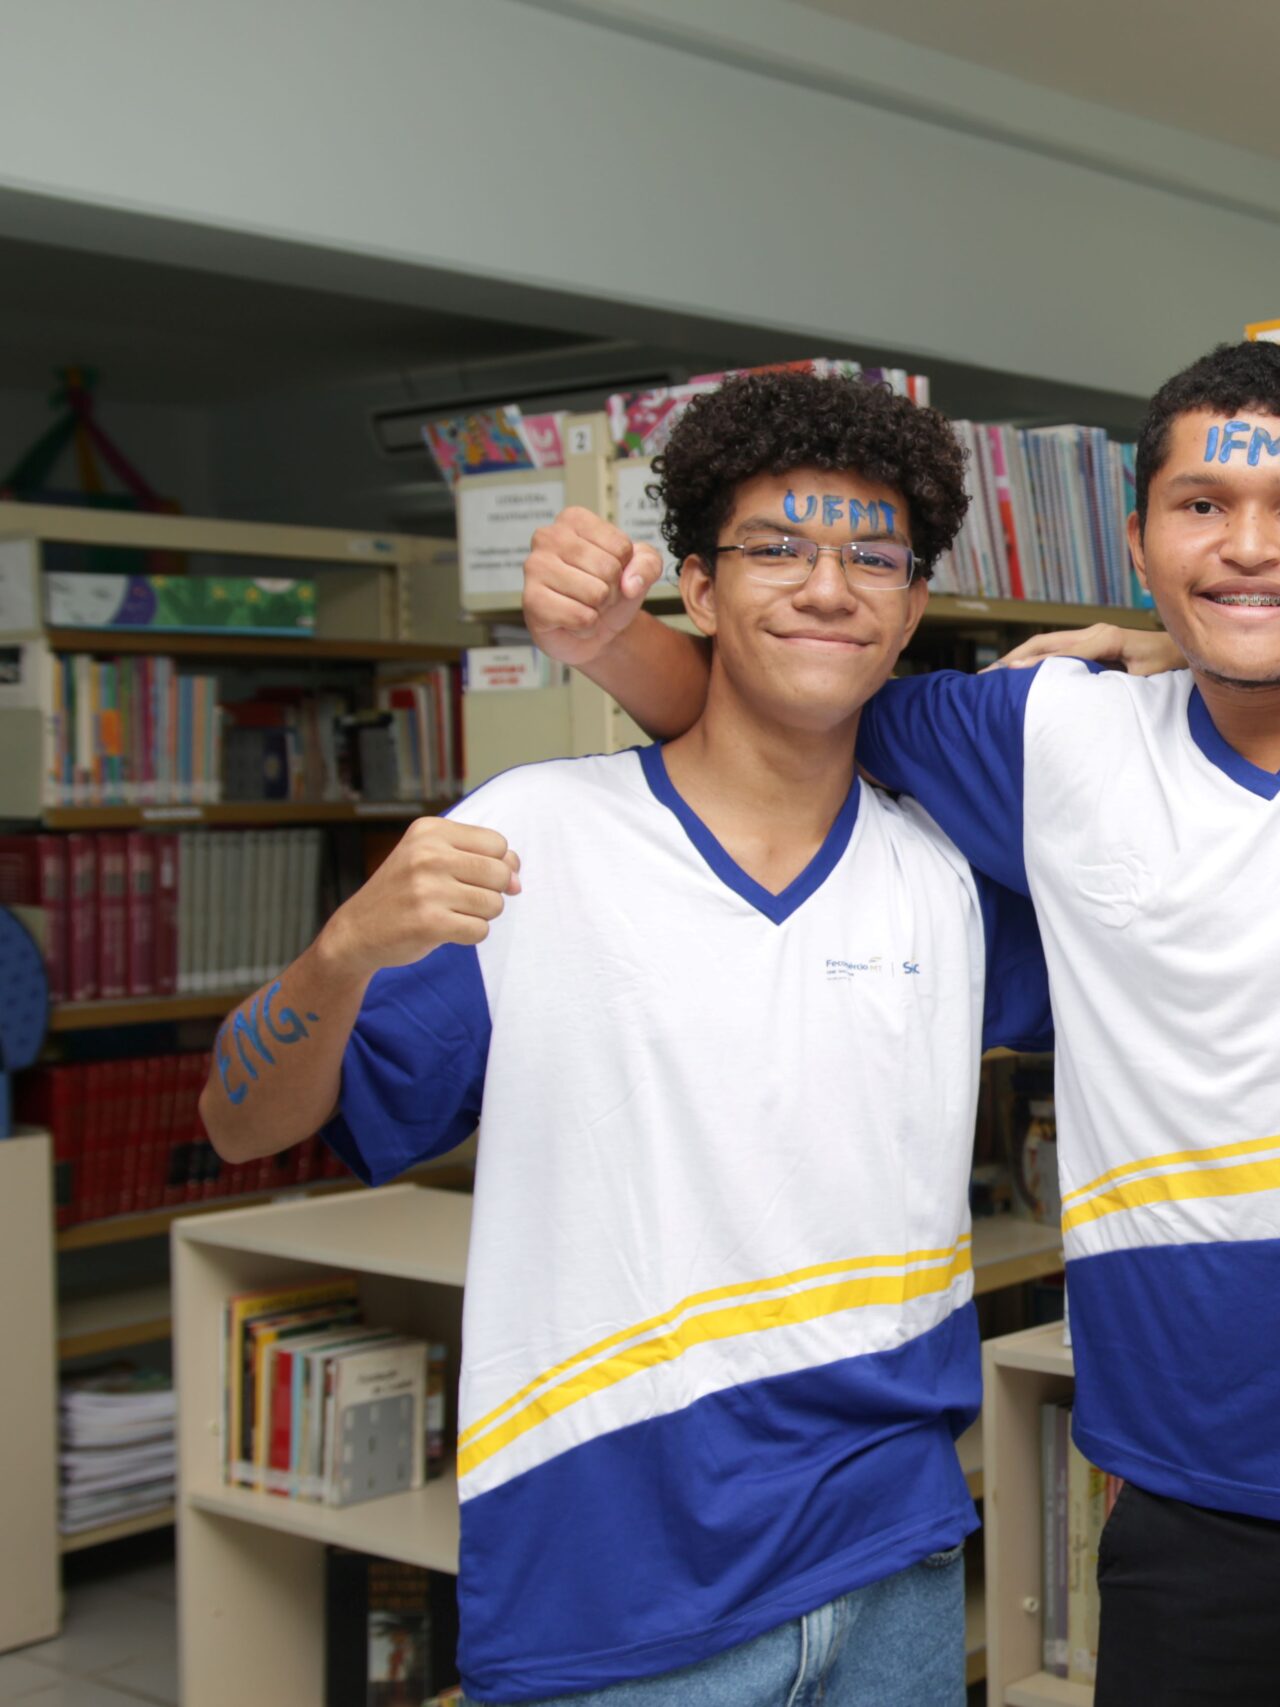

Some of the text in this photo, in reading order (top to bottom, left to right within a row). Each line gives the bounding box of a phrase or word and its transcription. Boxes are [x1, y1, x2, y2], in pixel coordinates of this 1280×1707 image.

[575, 431, 586, 450] 2
[783, 489, 897, 536] UFMT
[214, 980, 321, 1106] ENG.
